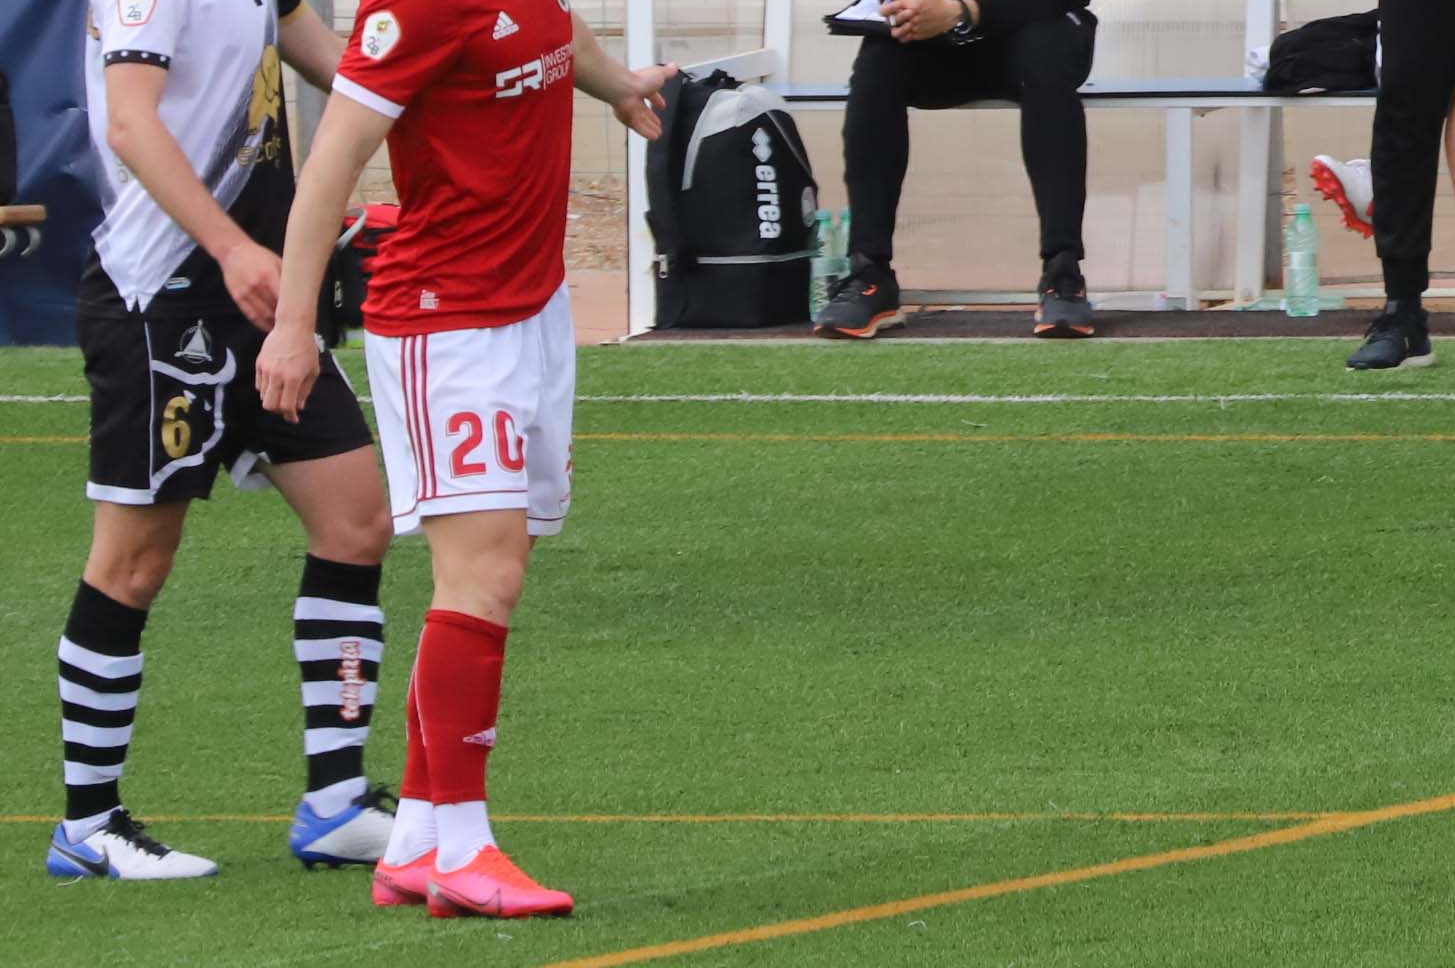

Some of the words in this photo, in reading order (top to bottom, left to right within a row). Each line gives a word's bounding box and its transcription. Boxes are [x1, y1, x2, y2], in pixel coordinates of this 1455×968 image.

[755, 164, 781, 239] errea
[161, 395, 192, 460] 6
[445, 409, 525, 478] 20
